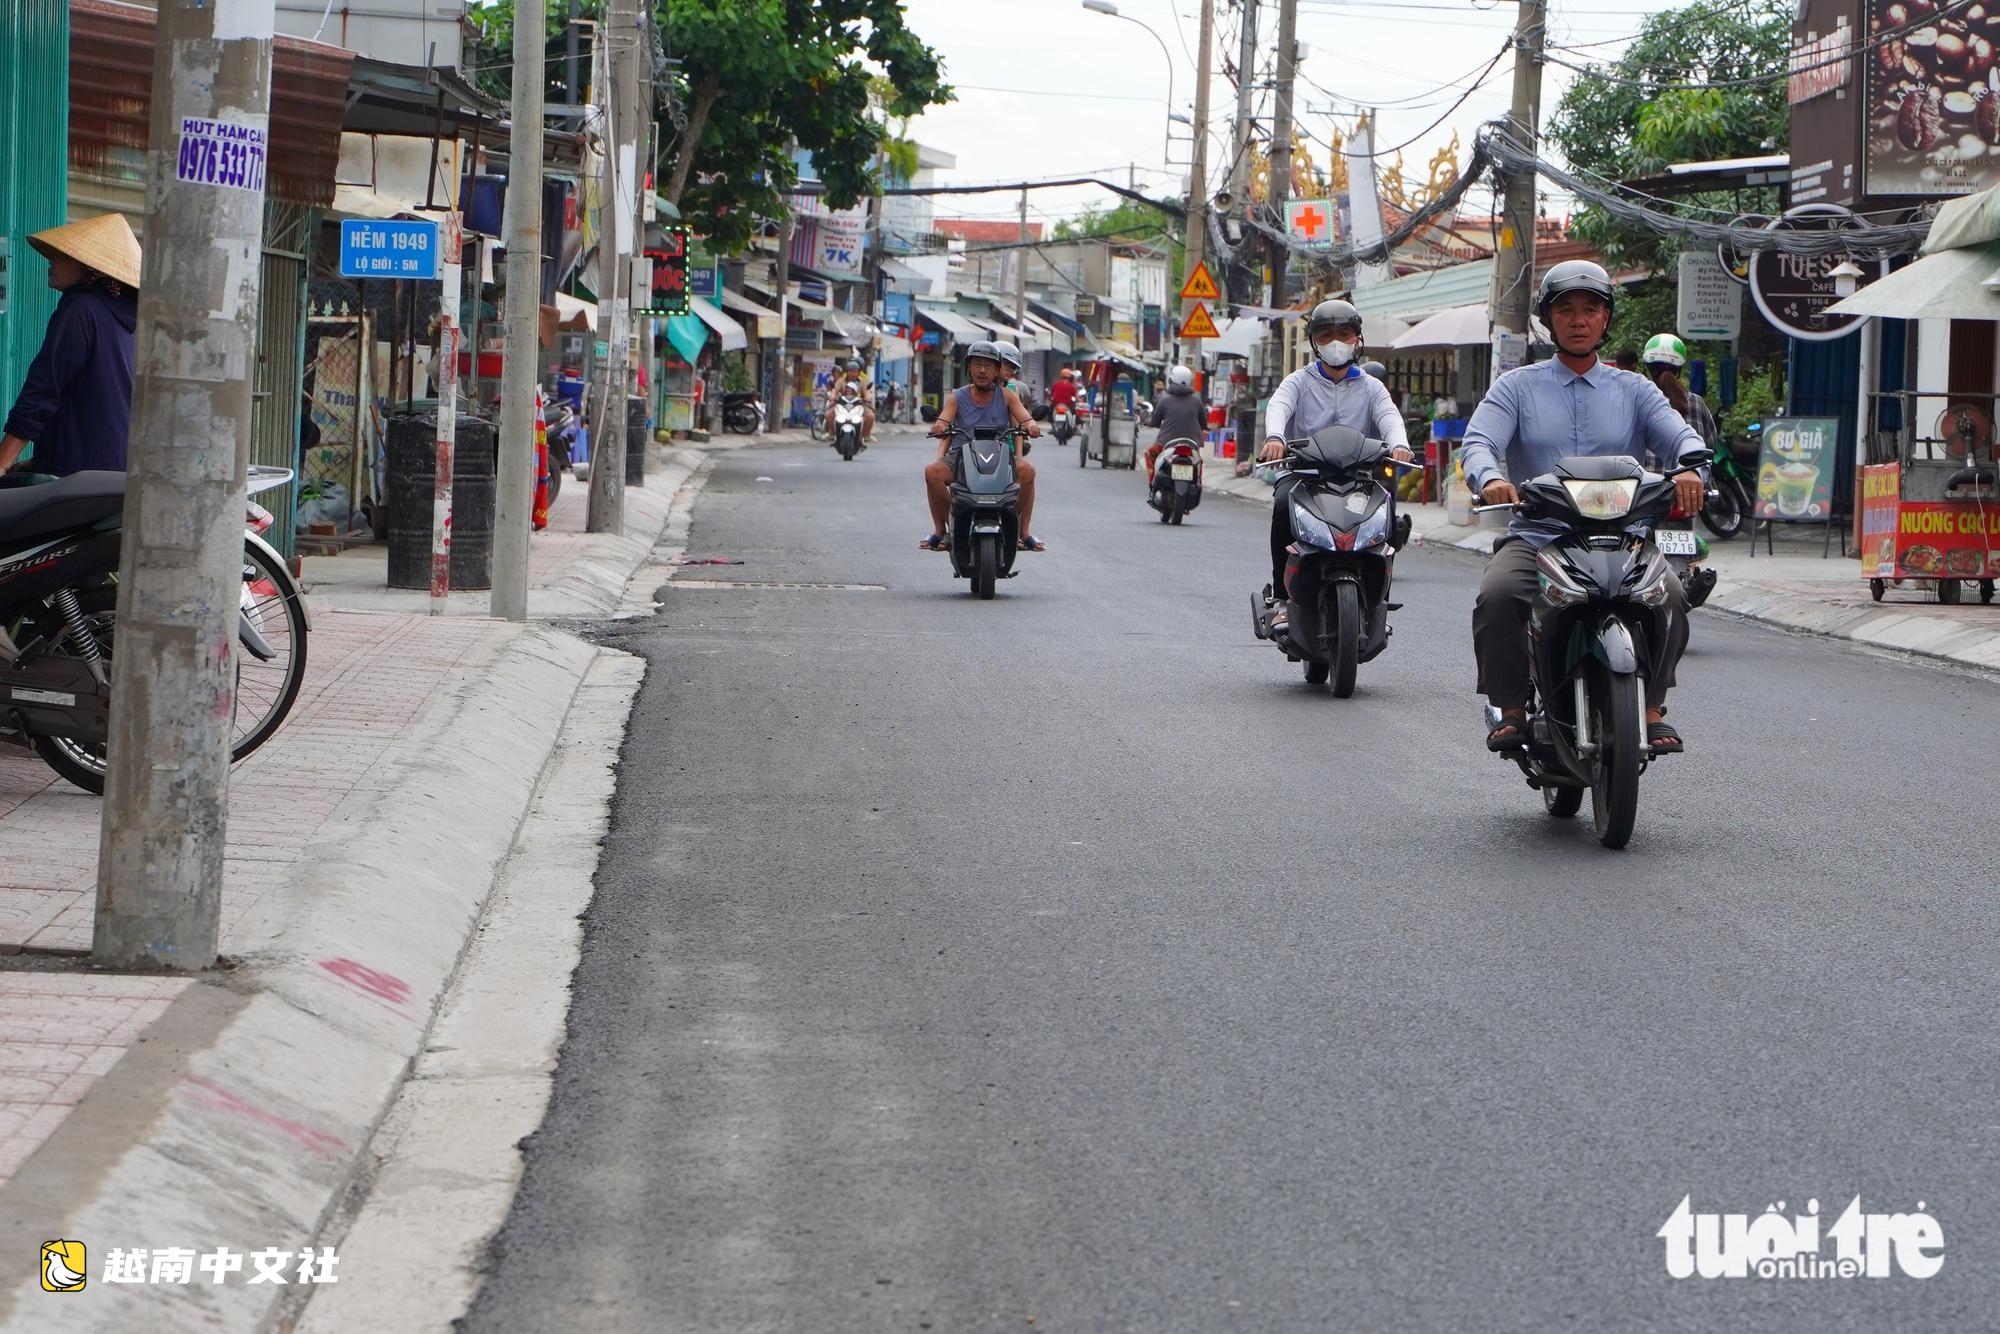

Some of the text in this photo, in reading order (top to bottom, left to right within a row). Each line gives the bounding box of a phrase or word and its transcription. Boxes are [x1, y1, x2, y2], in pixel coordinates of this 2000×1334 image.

[351, 225, 428, 251] HẺM 1949
[355, 256, 368, 272] LỘ
[402, 259, 418, 271] 5M
[826, 249, 853, 263] 7K
